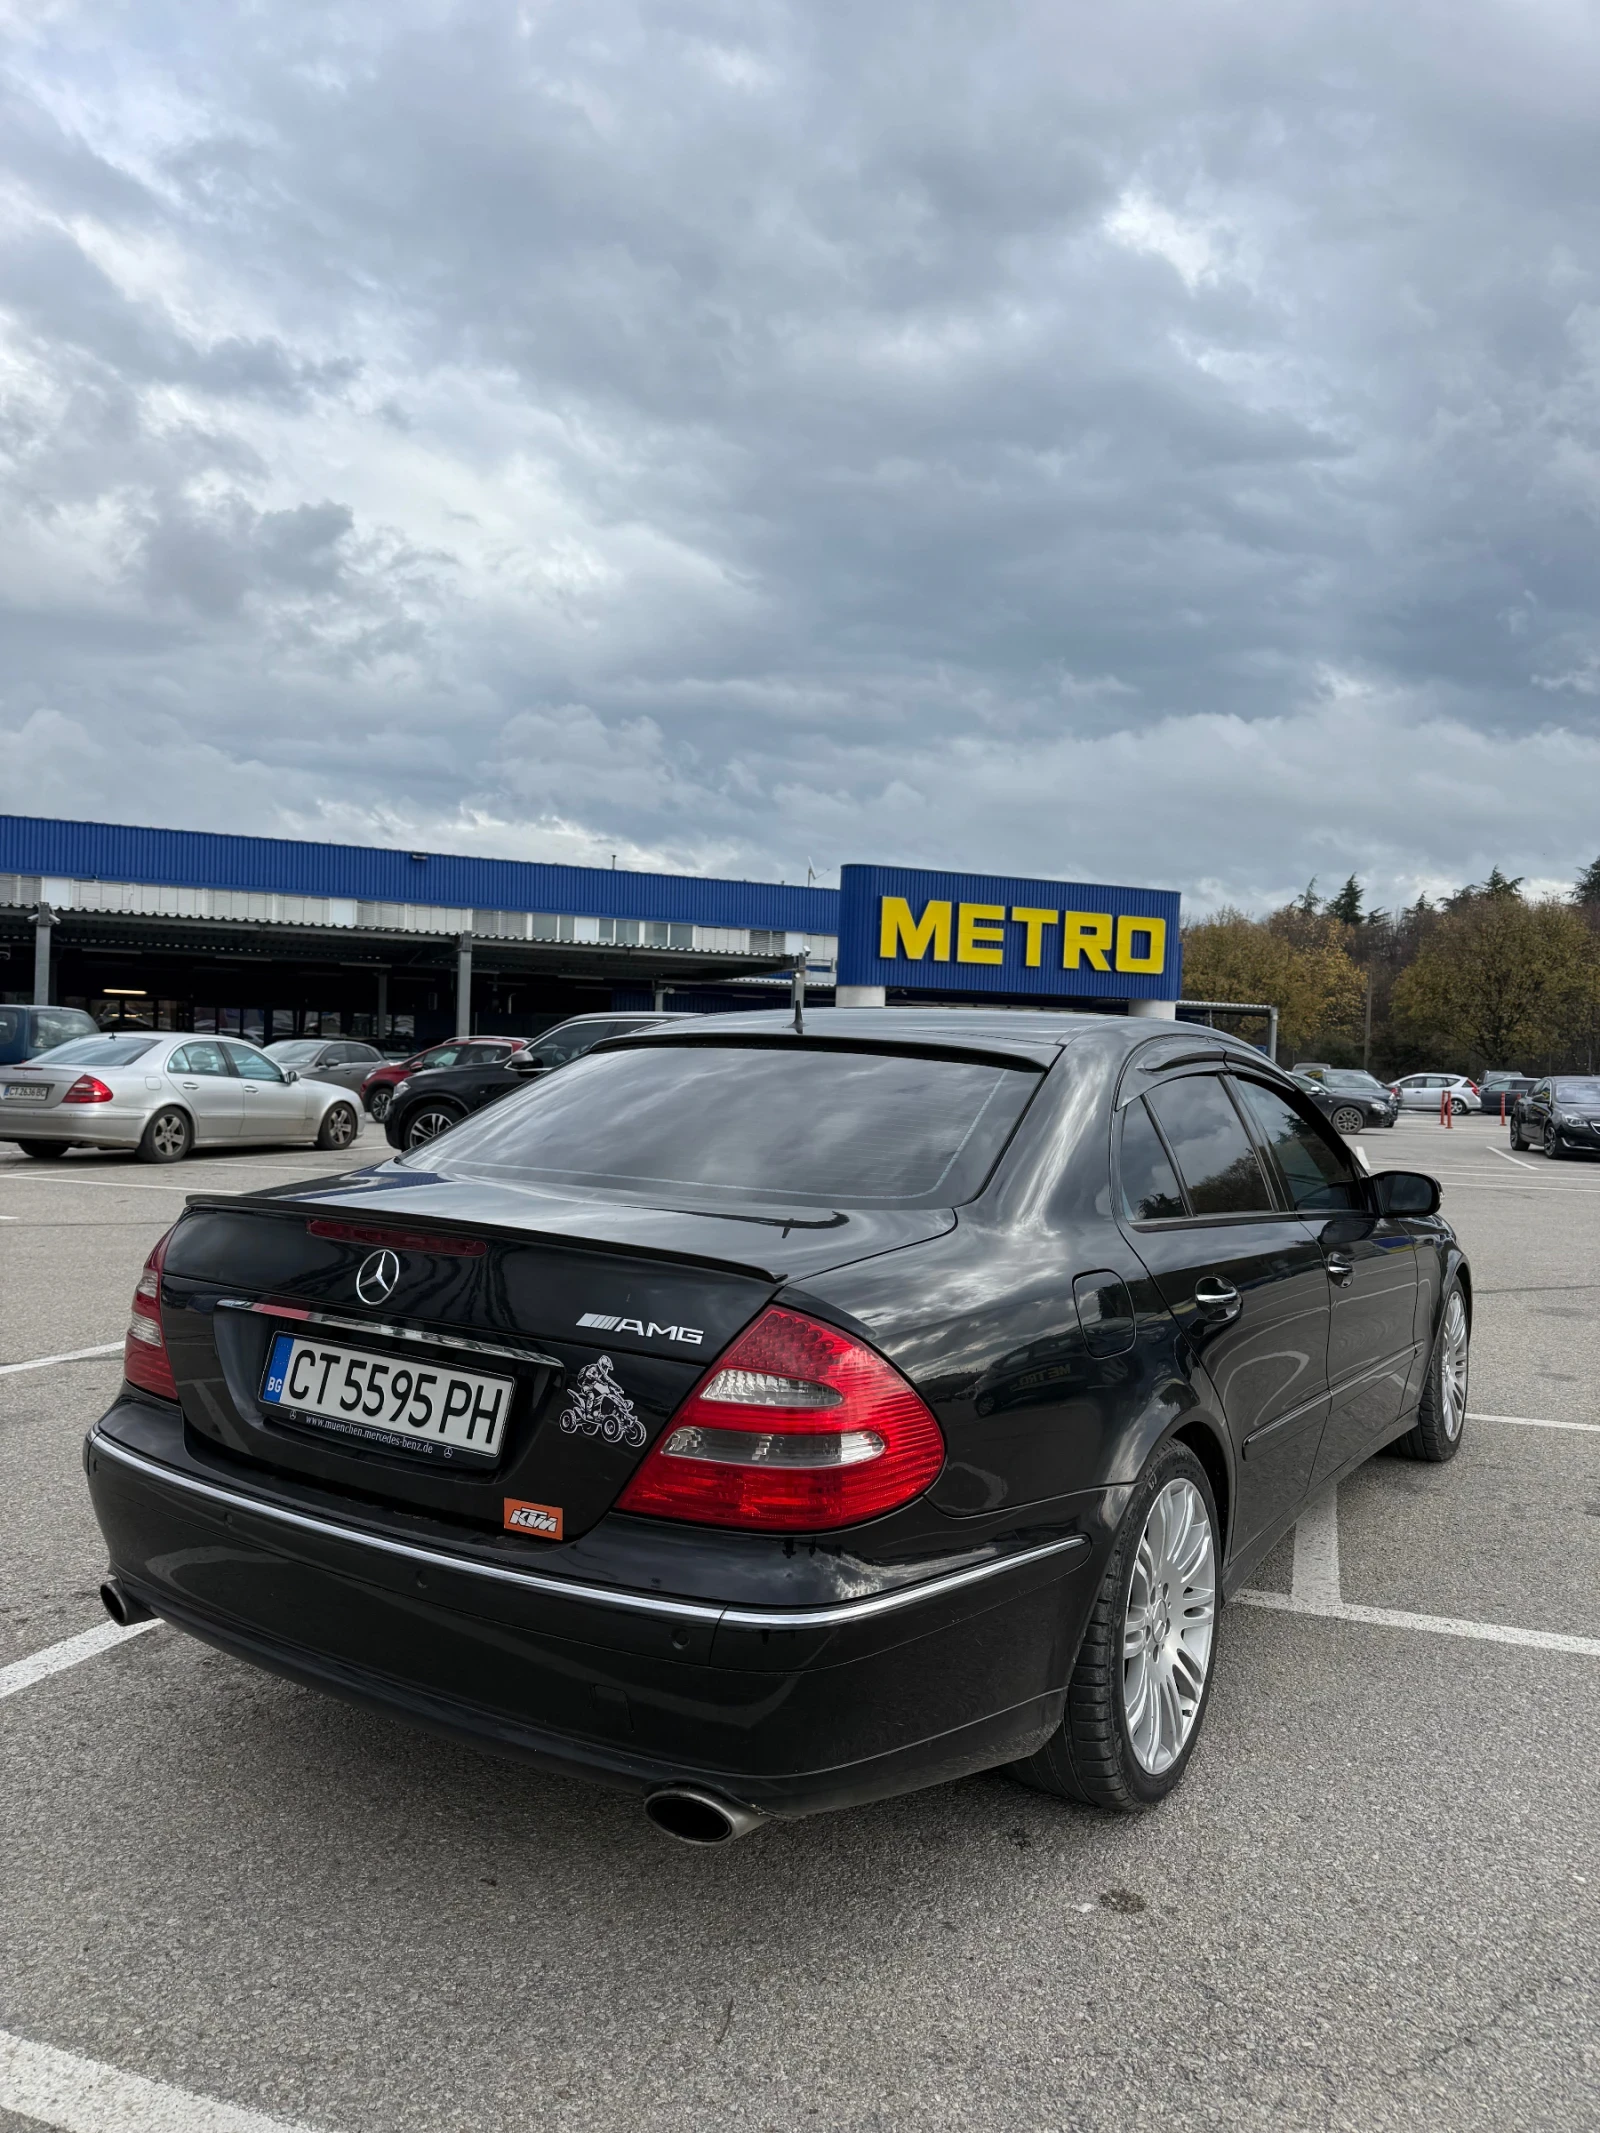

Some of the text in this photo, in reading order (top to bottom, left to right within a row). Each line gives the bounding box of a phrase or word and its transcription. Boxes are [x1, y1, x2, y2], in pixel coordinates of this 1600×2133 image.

[879, 895, 1166, 975] METRO
[614, 1318, 705, 1345] AMG
[267, 1376, 283, 1393] BG
[288, 1349, 503, 1444] CT 5595 PH
[305, 1415, 434, 1454] www.muenchen.mercedes-benz.de
[508, 1506, 559, 1534] KTM
